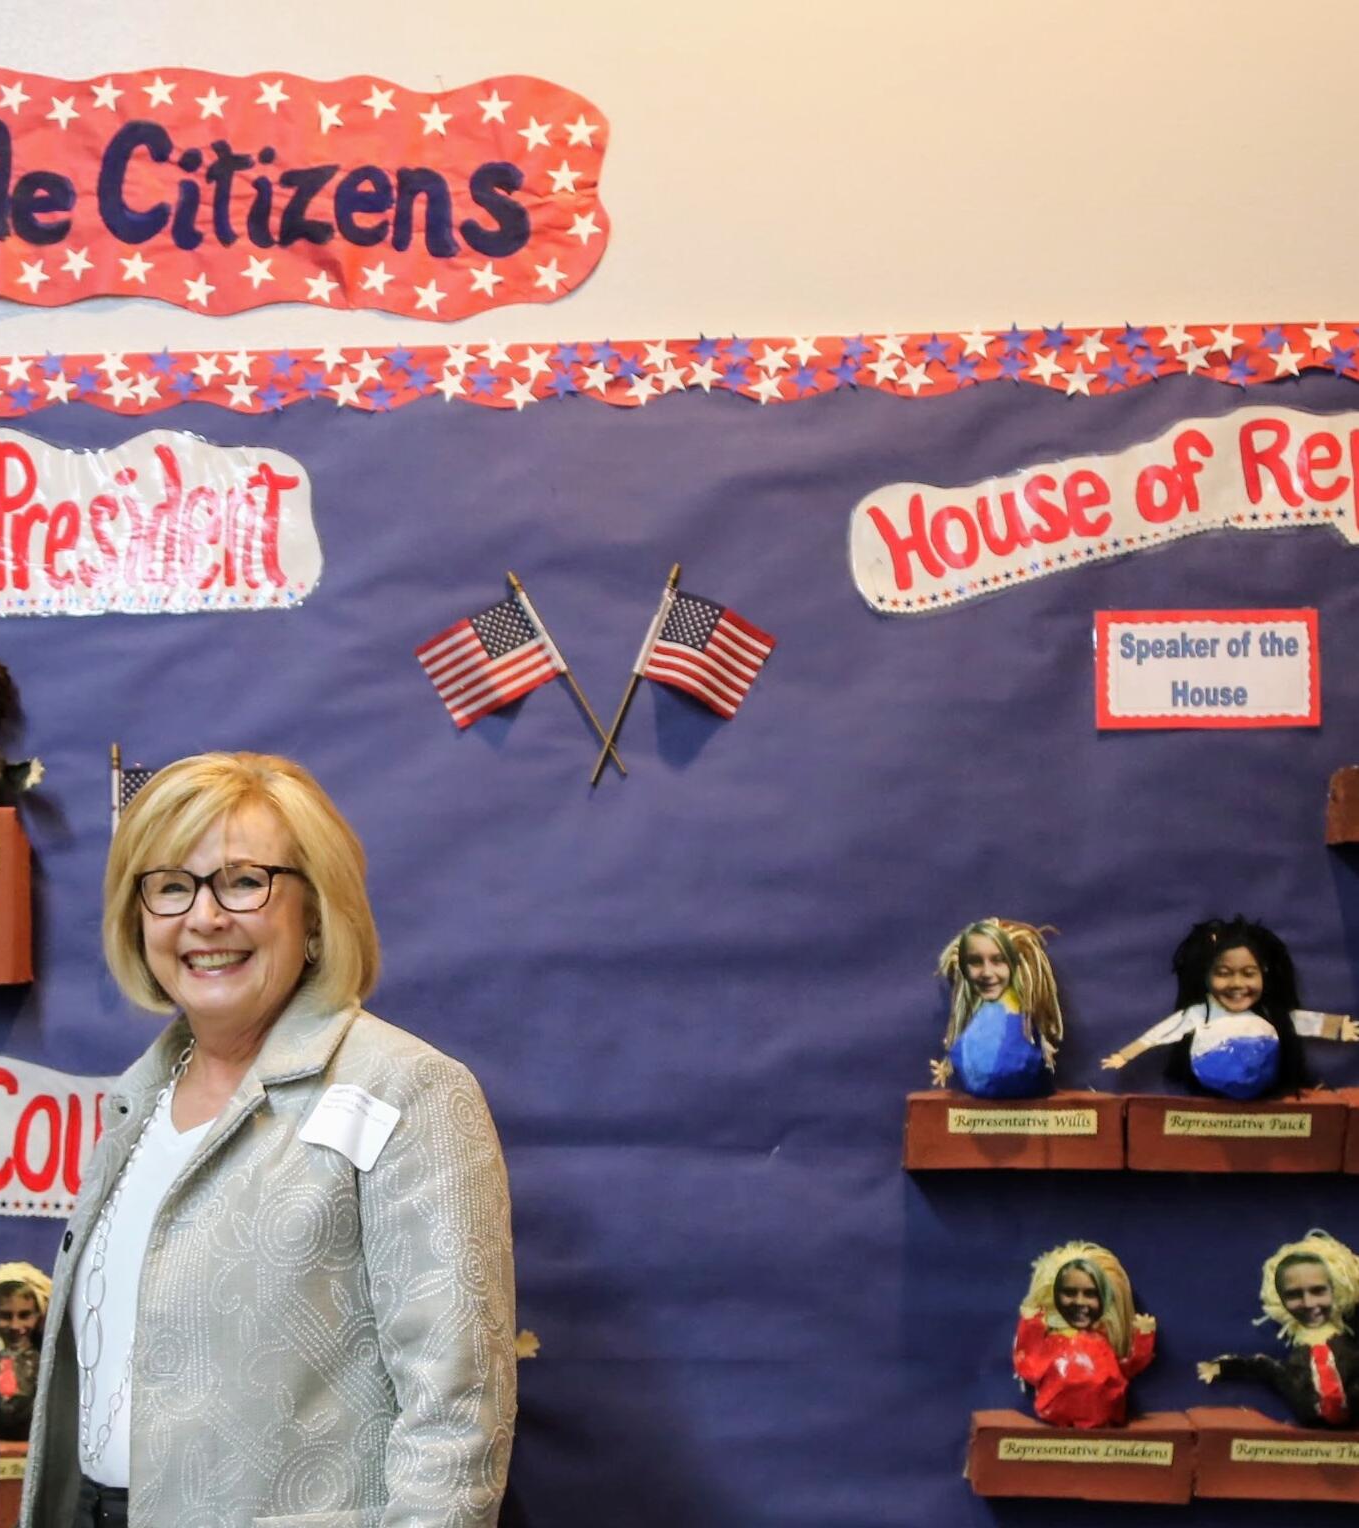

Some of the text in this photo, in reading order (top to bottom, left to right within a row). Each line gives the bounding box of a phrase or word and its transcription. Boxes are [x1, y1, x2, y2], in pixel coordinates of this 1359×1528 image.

[98, 122, 529, 257] Citizens
[865, 468, 1113, 591] House
[1135, 428, 1215, 524] of
[1119, 631, 1300, 665] Speaker of the
[1171, 681, 1249, 708] House
[954, 1111, 1092, 1133] Representative Willis
[1170, 1114, 1265, 1132] Representative
[1004, 1441, 1169, 1461] Representative Lindekens
[1235, 1442, 1332, 1460] Representative
